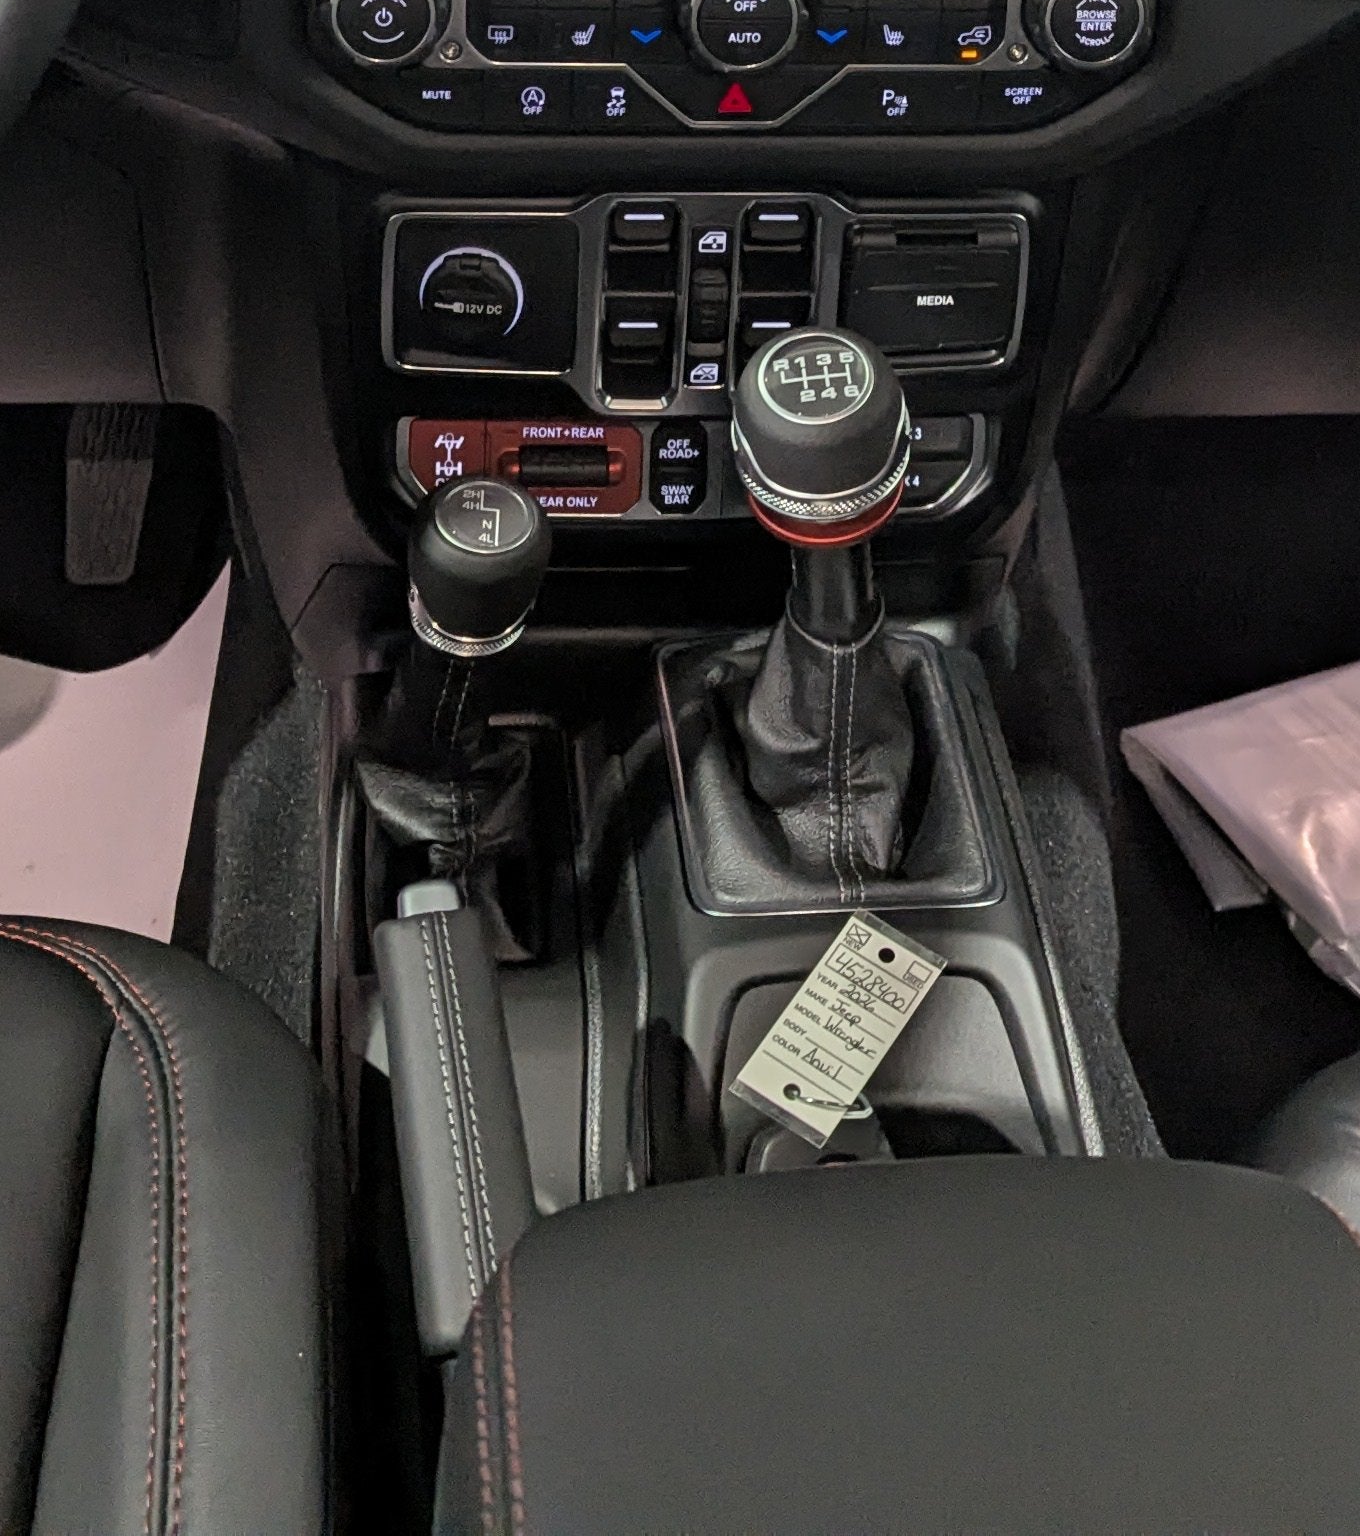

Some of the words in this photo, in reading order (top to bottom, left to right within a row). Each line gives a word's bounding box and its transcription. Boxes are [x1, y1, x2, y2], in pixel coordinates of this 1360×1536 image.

[734, 0, 757, 12] OFF
[1077, 10, 1116, 20] BROWSE
[1081, 21, 1113, 32] ENTER
[728, 32, 761, 44] AUTO
[1079, 35, 1110, 47] SCROLL
[422, 90, 452, 100] MUTE
[1004, 87, 1042, 97] SCREEN
[1012, 96, 1031, 104] OFF
[523, 106, 543, 115] OFF
[606, 108, 626, 117] OFF
[887, 107, 906, 116] OFF
[916, 295, 954, 306] MEDIA
[465, 304, 485, 315] 12V
[487, 305, 502, 315] DC
[773, 360, 789, 372] R
[794, 357, 805, 367] 1
[817, 354, 832, 366] 3
[839, 352, 854, 363] 5
[800, 390, 816, 403] 2
[821, 387, 837, 399] 4
[844, 385, 859, 397] 6
[522, 427, 603, 439] FRONT+REAR
[667, 439, 690, 449] OFF
[659, 448, 699, 459] ROAD+
[462, 490, 480, 498] 2H
[661, 486, 693, 495] SWAY
[536, 496, 564, 508] EAR
[567, 496, 599, 508] ONLY
[664, 494, 689, 504] BAR
[462, 501, 480, 510] 4H
[482, 520, 492, 530] N
[478, 533, 494, 543] 4L
[844, 936, 864, 950] NEW
[816, 973, 838, 990] YEAR
[804, 988, 828, 1006] MAKE
[828, 998, 860, 1026] Jeep
[793, 1004, 821, 1024] MODEL
[783, 1018, 806, 1036] BODY
[772, 1034, 800, 1056] COLOR
